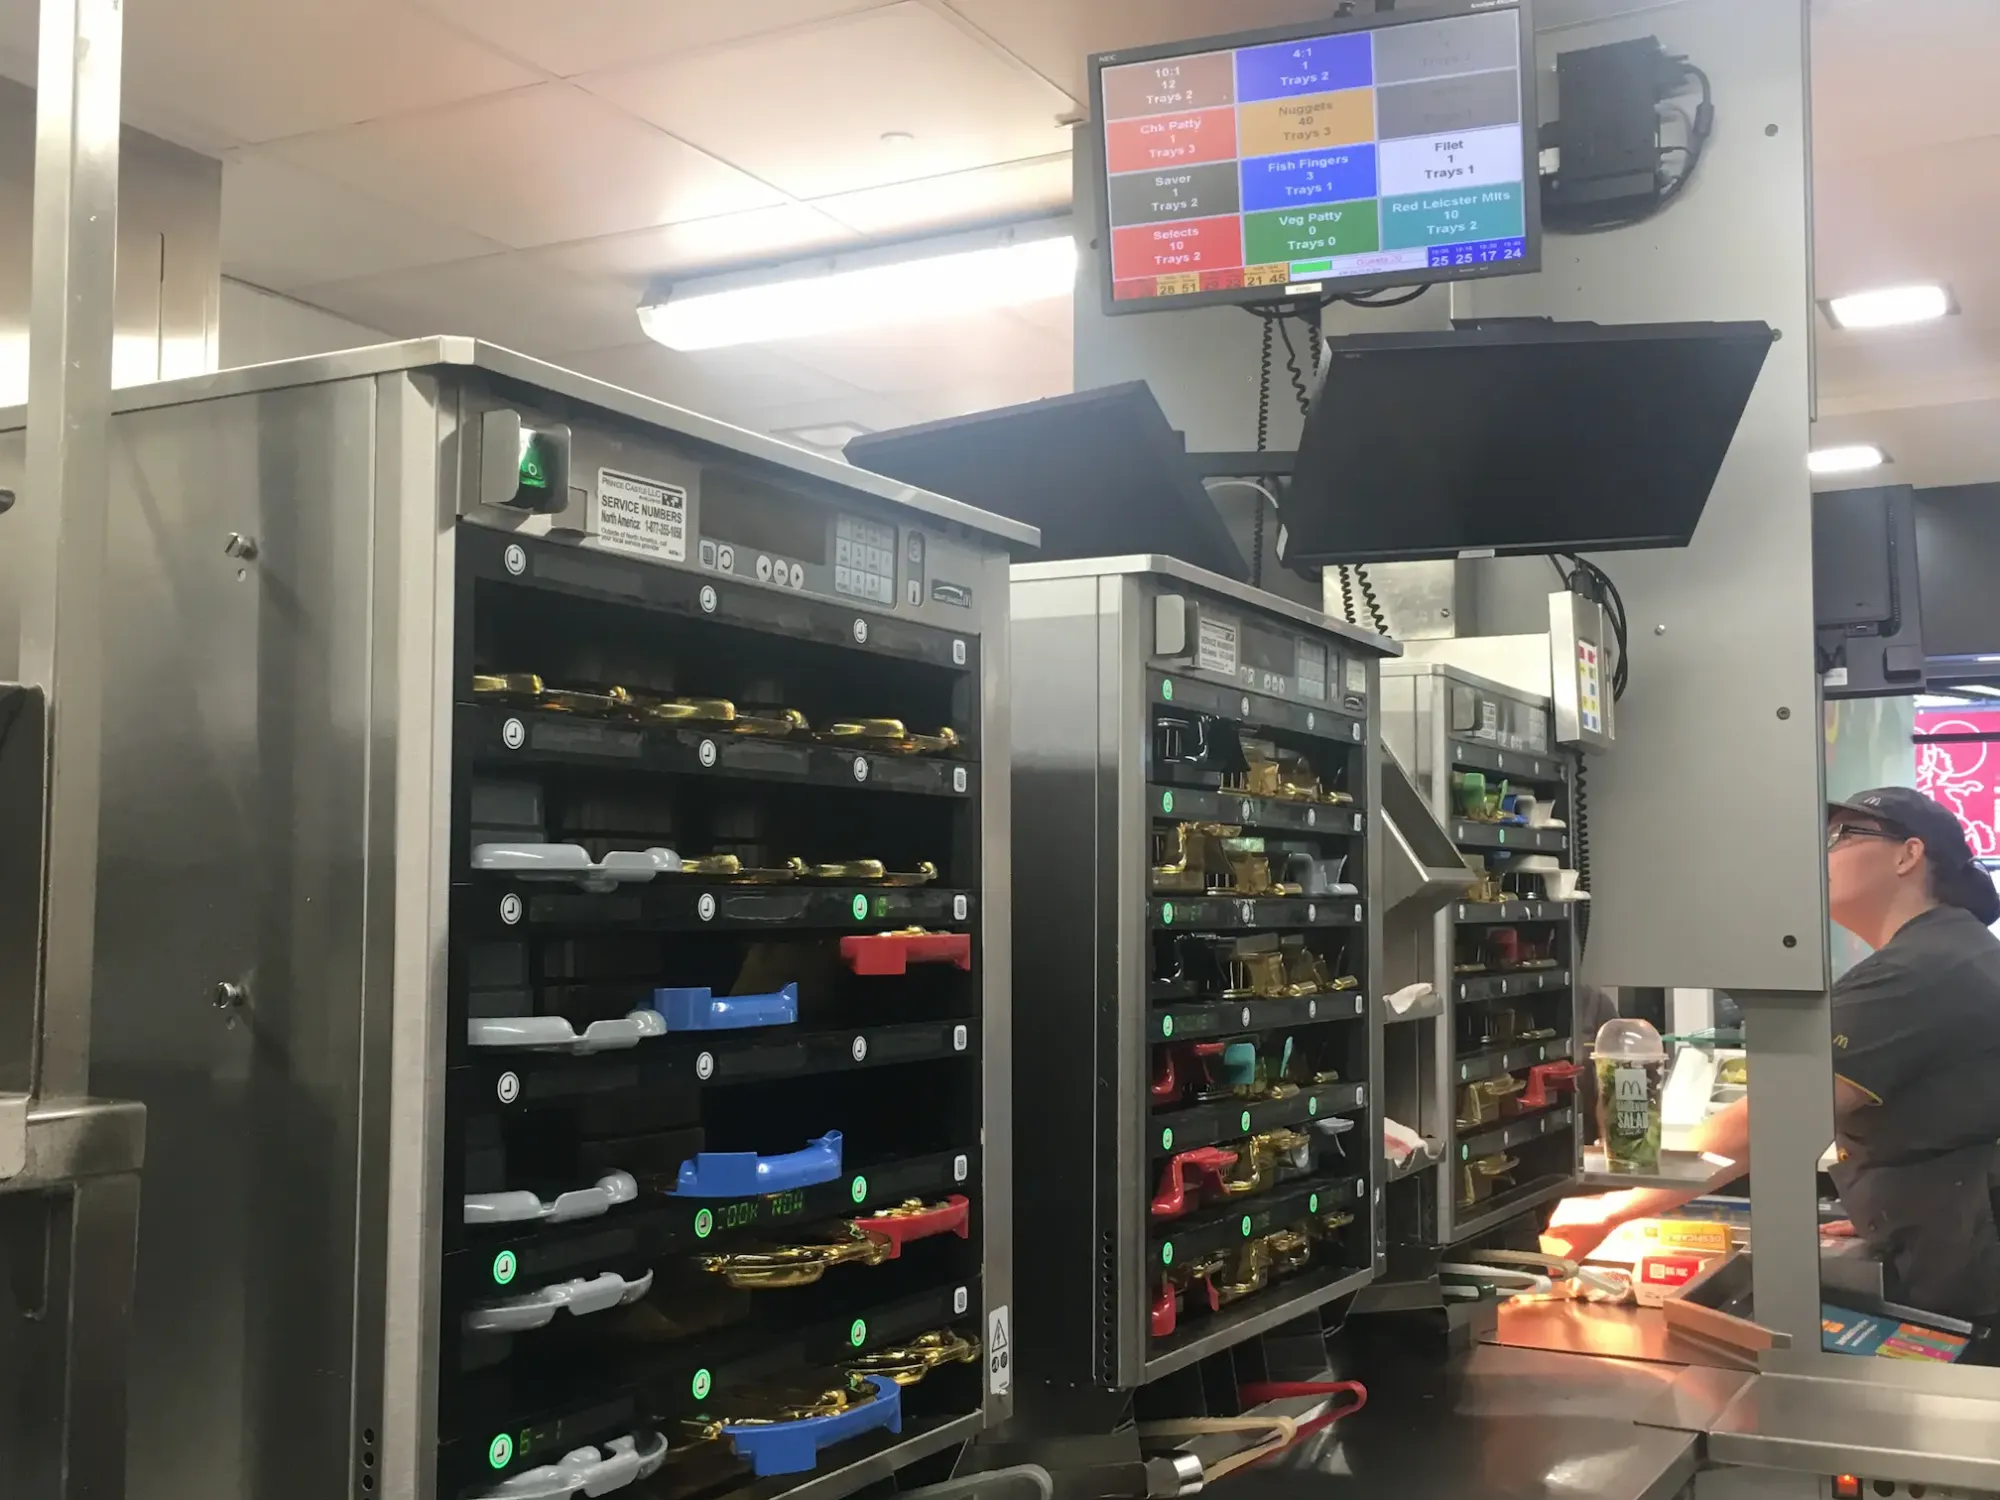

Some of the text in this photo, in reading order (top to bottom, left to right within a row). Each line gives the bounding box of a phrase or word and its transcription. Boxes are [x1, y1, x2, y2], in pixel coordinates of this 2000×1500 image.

[1292, 47, 1312, 58] 4:1
[1155, 66, 1180, 78] 10:1
[1302, 60, 1308, 70] 1
[1161, 79, 1176, 89] 12
[1280, 71, 1330, 86] Trays 2
[1146, 89, 1193, 104] Trays 2
[1279, 101, 1334, 116] Nuggets
[1140, 117, 1202, 134] Chk Patty
[1298, 116, 1314, 125] 40
[1170, 134, 1176, 144] 1
[1283, 126, 1331, 141] Trays 3
[1148, 144, 1196, 159] Trays 3
[1434, 140, 1464, 152] Filet
[1268, 155, 1349, 173] Fish Fingers
[1448, 154, 1454, 163] 1
[1306, 171, 1314, 180] 3
[1425, 164, 1475, 179] Trays 1
[1155, 174, 1192, 187] Saver
[1172, 187, 1179, 197] 1
[1285, 181, 1333, 196] Trays 1
[1151, 198, 1199, 212] Trays 2
[1392, 201, 1418, 213] Red
[1279, 211, 1342, 227] Veg Patty
[1444, 210, 1459, 220] 10
[1153, 228, 1199, 240] Selects
[1308, 225, 1317, 235] 0
[1426, 220, 1478, 235] Trays 2
[1169, 241, 1184, 251] 10
[1288, 236, 1336, 250] Trays 0
[1154, 251, 1201, 265] Trays 2
[1431, 248, 1522, 267] 25 25 17 24
[1160, 285, 1175, 295] 28
[1182, 283, 1196, 293] 51
[1247, 276, 1262, 286] 21
[1269, 274, 1286, 284] 45
[601, 494, 682, 524] SERVICE NUMBERS
[601, 510, 617, 524] North
[1617, 1111, 1649, 1129] SALAD
[771, 1191, 804, 1217] NOW
[1667, 1234, 1723, 1243] DESPICA
